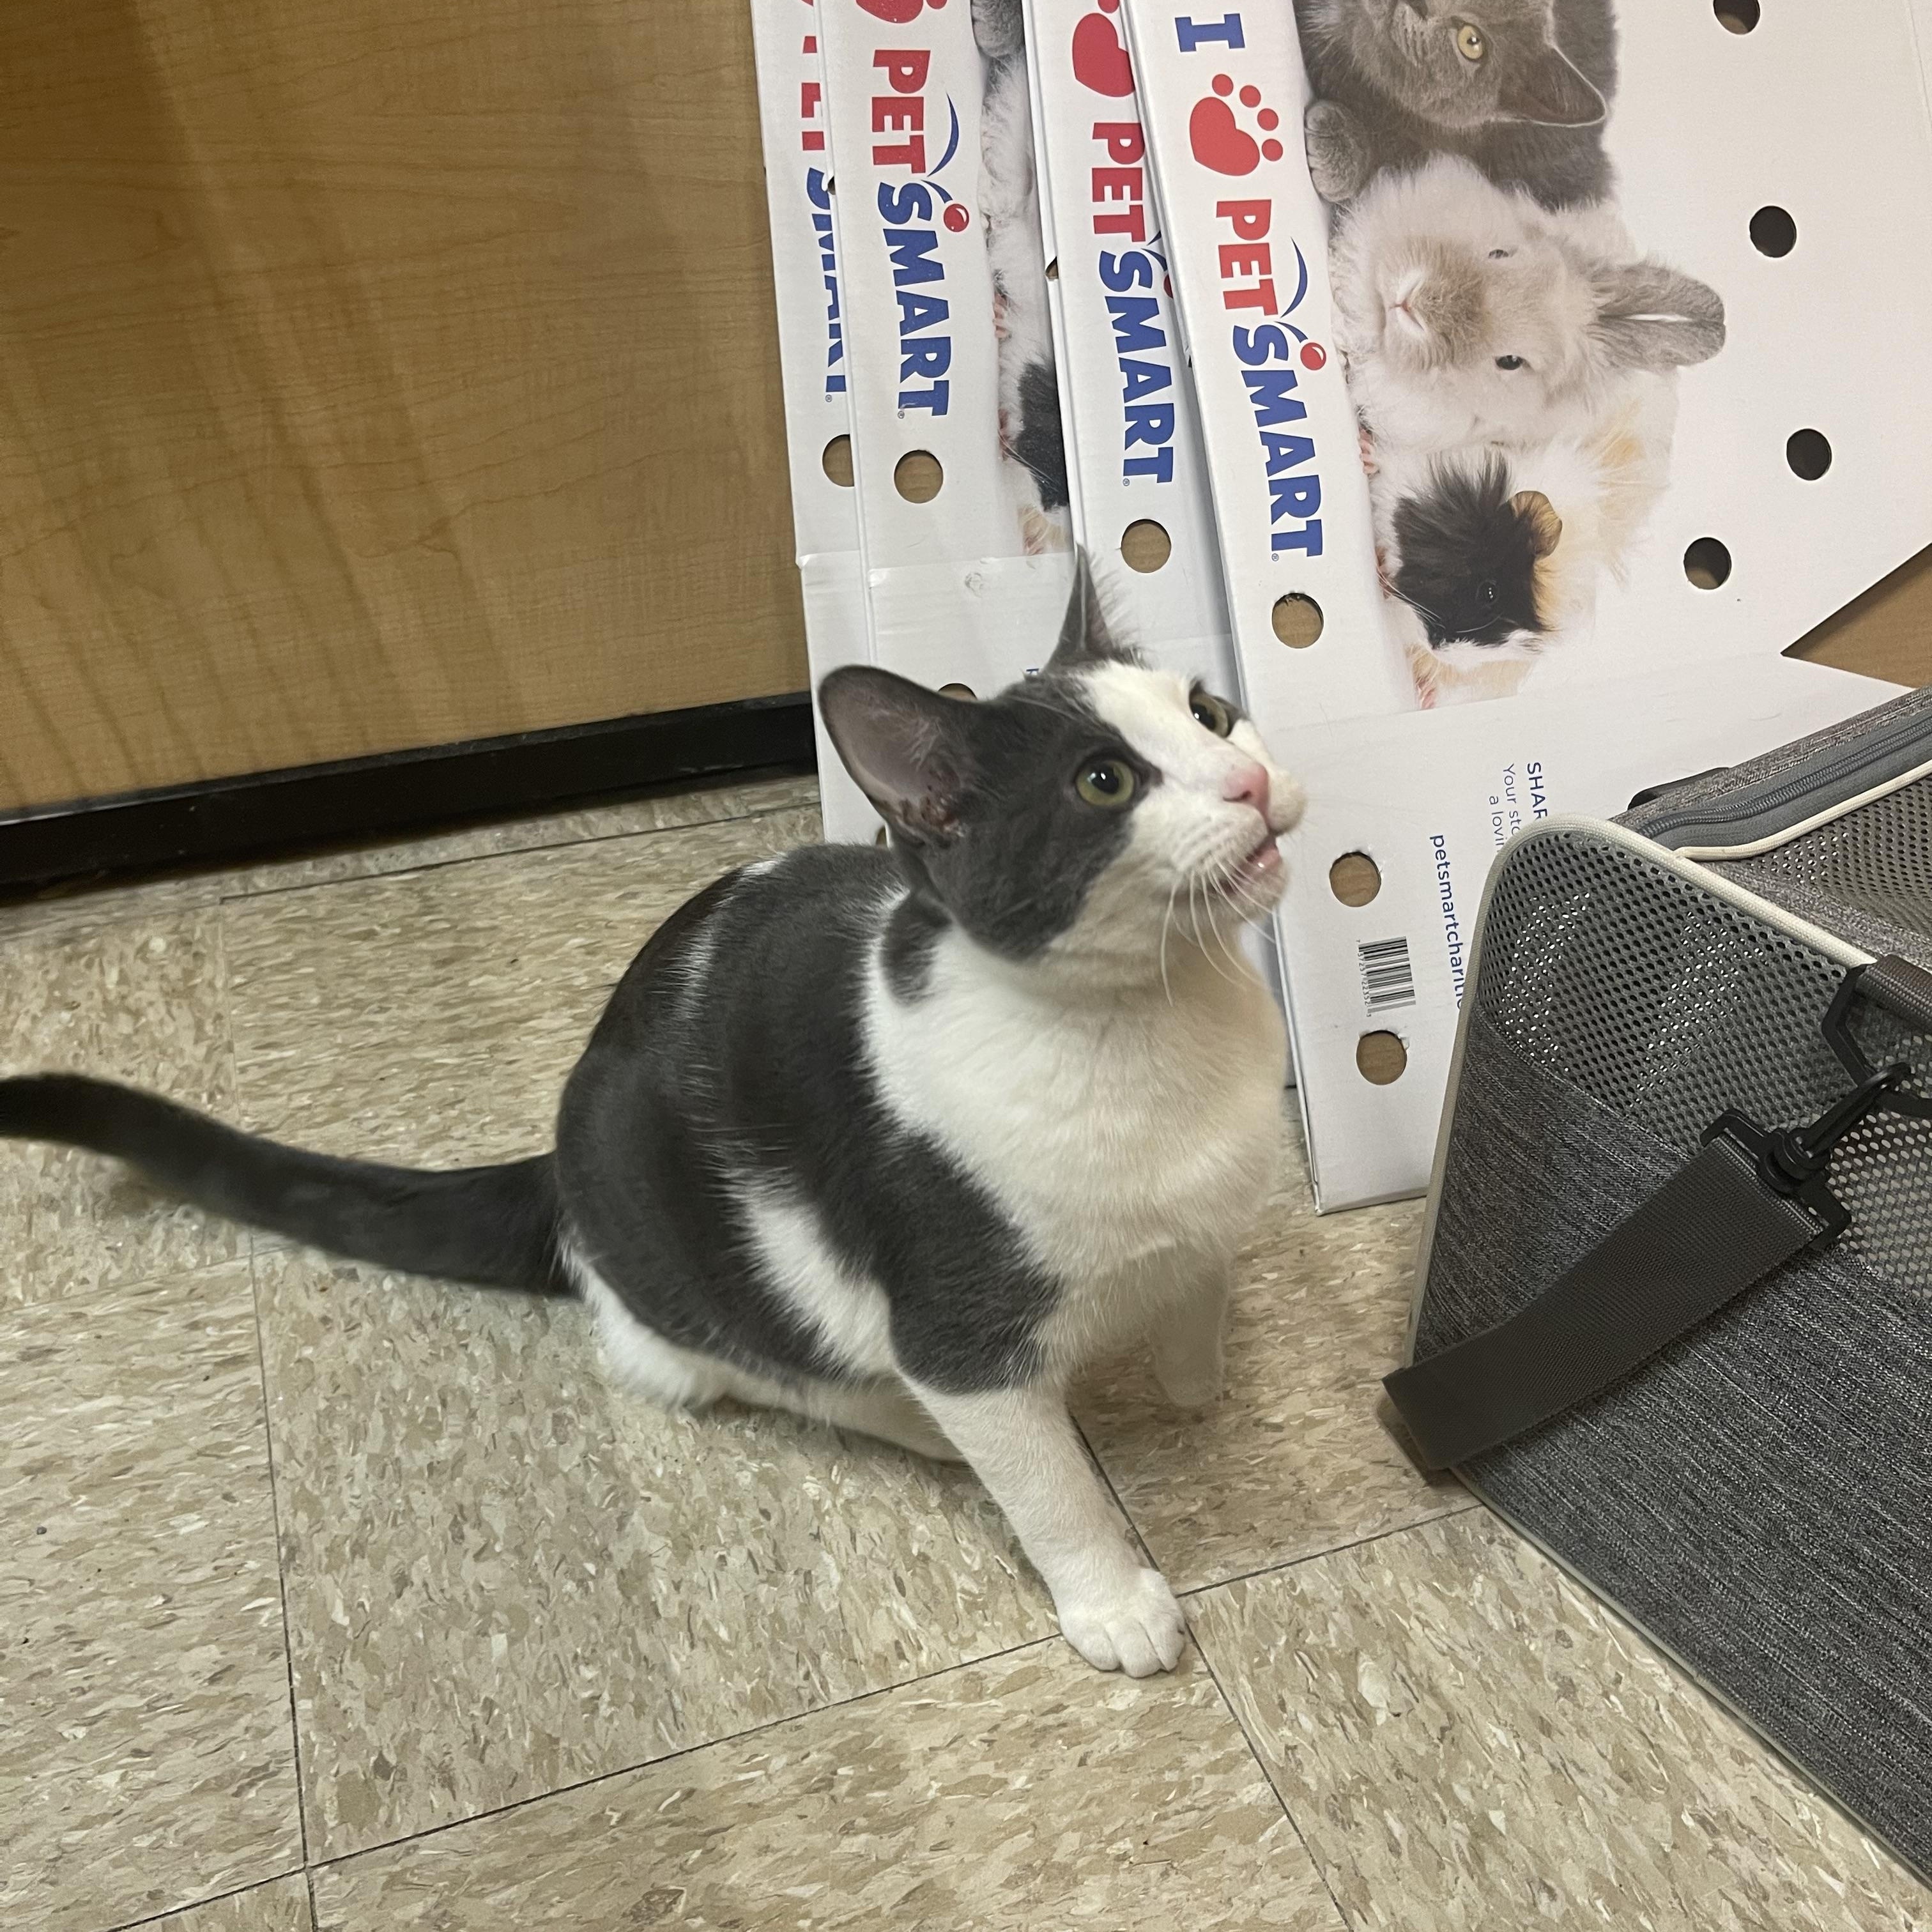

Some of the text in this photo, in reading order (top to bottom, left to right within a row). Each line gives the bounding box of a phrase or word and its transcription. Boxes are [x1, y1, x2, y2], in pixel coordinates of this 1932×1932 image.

[871, 49, 951, 417] PETSMART
[1091, 122, 1175, 484] PETSMART
[1174, 13, 1322, 557] I PETSMART
[1489, 795, 1499, 805] a
[1503, 763, 1517, 804] Your
